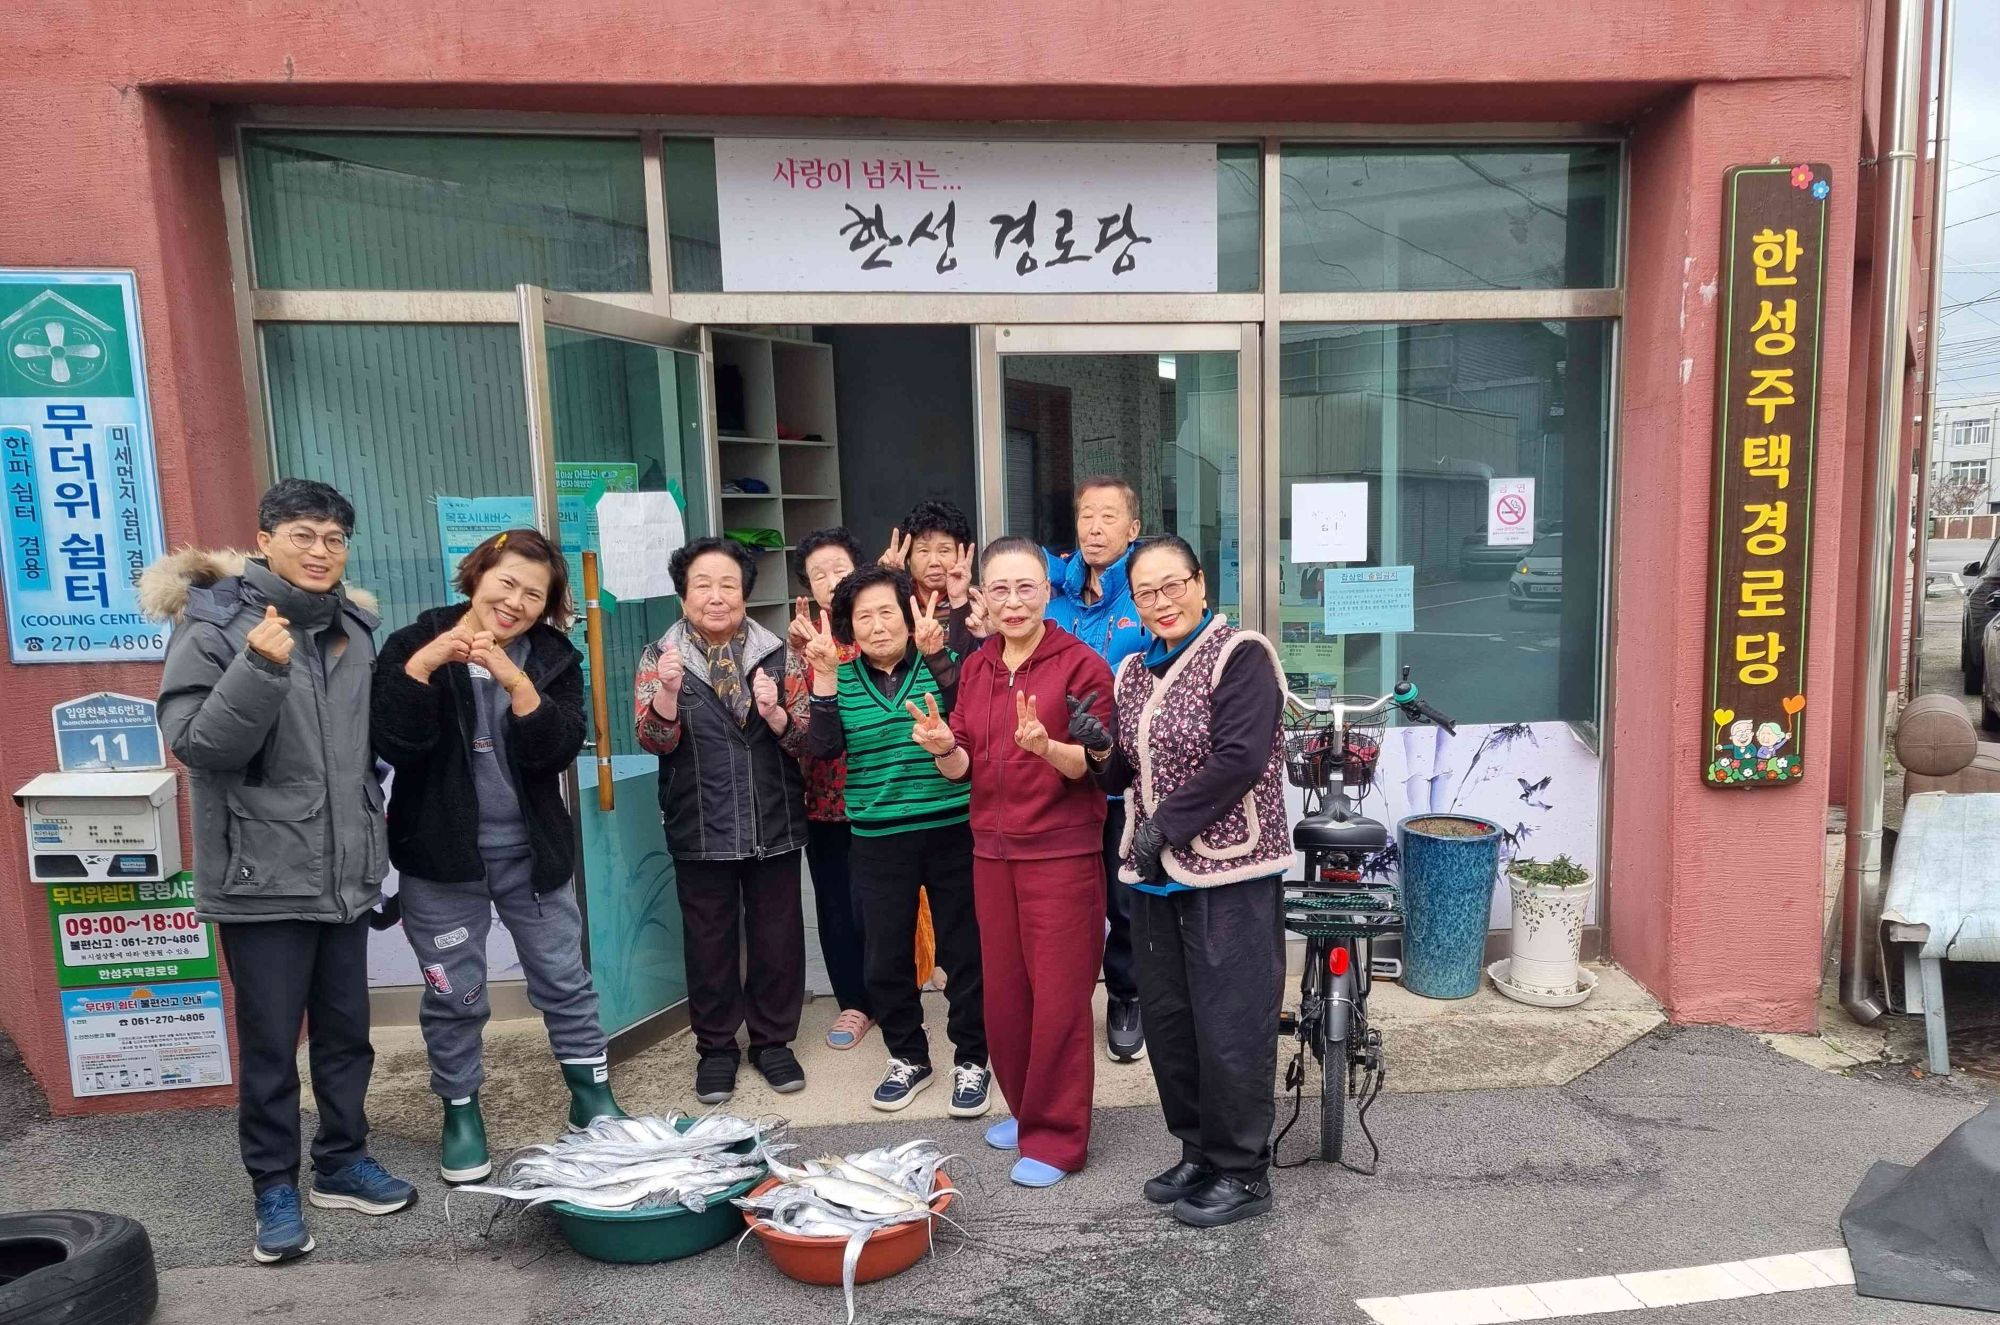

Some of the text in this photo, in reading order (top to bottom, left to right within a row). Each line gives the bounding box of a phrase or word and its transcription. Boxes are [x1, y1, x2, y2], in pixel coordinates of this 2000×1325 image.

[772, 158, 962, 191] 사랑이 넘치는...
[840, 200, 1152, 276] 한성 경로당
[112, 426, 136, 504] 미세먼지
[1735, 228, 1803, 686] 한성주택경로당
[4, 436, 45, 580] 한파 쉼터 겸용
[42, 404, 110, 609] 무더위 쉼터
[445, 511, 512, 524] 목포시내버스
[121, 507, 142, 546] 쉼터
[21, 614, 95, 628] (COOLING
[51, 634, 163, 652] 270-4806
[65, 704, 145, 719] 입암천북로6번길
[89, 733, 129, 762] 11
[52, 884, 135, 905] 무더위쉼터
[65, 911, 200, 937] 09:00~18:00
[70, 938, 113, 951] 불편신고
[121, 934, 200, 948] 061-270-4806
[98, 965, 178, 980] 한성주택경로당
[85, 1001, 115, 1013] 무더위
[118, 1000, 138, 1010] 쉼터
[181, 995, 203, 1005] 안내
[131, 1013, 205, 1027] 061-270-4806
